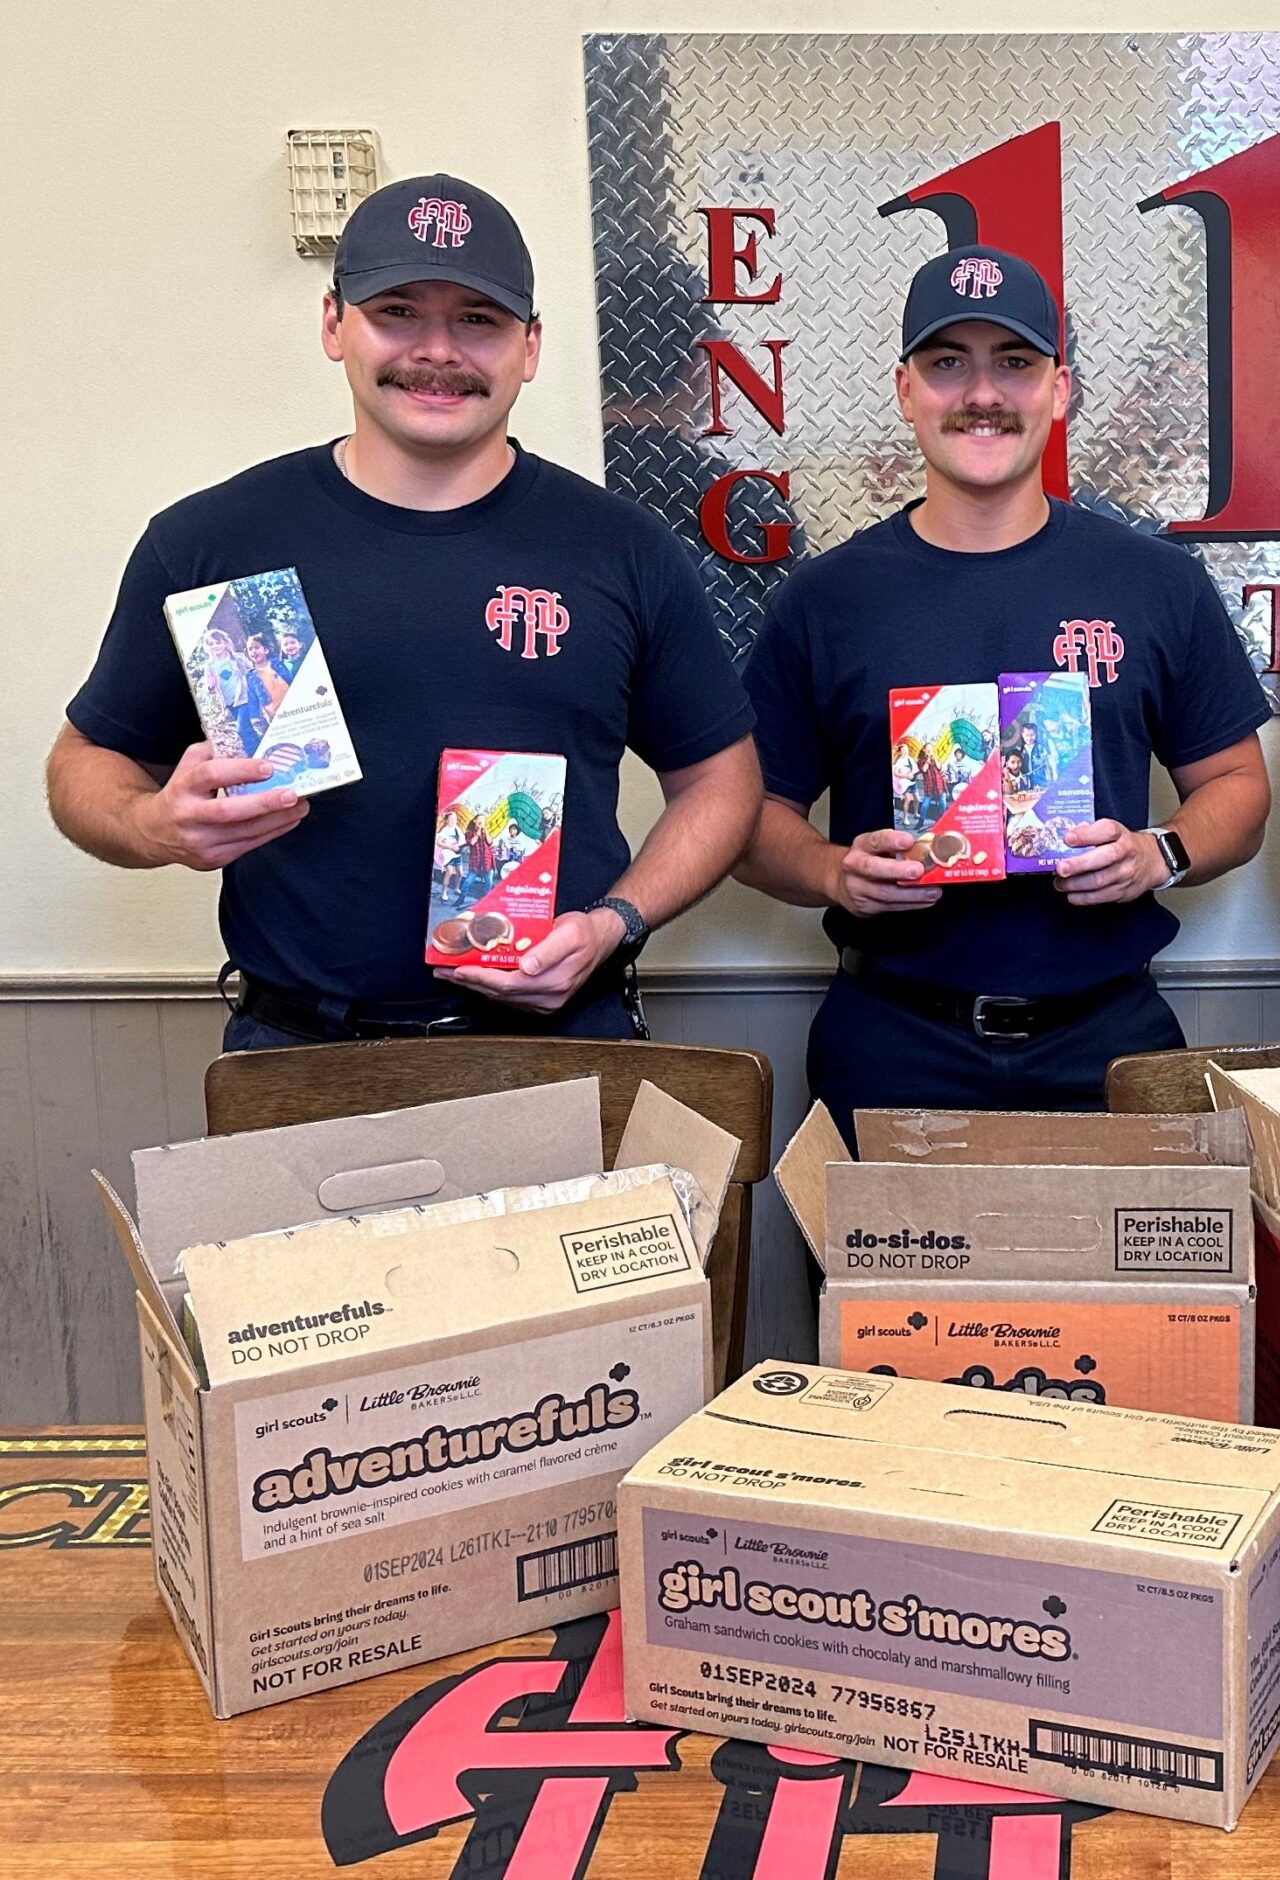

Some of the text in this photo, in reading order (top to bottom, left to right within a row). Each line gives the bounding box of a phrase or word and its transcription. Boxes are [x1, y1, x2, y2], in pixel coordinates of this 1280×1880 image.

[571, 1224, 670, 1255] Perishable
[1123, 1215, 1225, 1235] Perishable
[576, 1240, 675, 1269] KEEP IN A COOL
[1124, 1236, 1224, 1249] KEEP IN A COOL
[1124, 1251, 1224, 1263] DRY LOCATION
[581, 1253, 679, 1282] DRY LOCATION
[847, 1253, 971, 1270] DO NOT DROP
[857, 1325, 912, 1339] girl scouts
[947, 1322, 1061, 1339] Little Brownie
[263, 1513, 317, 1535] Indulgent
[421, 1479, 464, 1497] cookies
[466, 1472, 490, 1488] with
[493, 1459, 537, 1480] caramel
[539, 1448, 582, 1468] flavored
[263, 1511, 385, 1550] and a hint of sea salt
[658, 1559, 742, 1613] girl
[744, 1580, 877, 1632] scout
[252, 1634, 423, 1694] NOT FOR RESALE
[664, 1615, 1070, 1695] Graham sandwich cookies with chocolaty and marshmallowy filling
[883, 1734, 1029, 1775] NOT FOR RESALE
